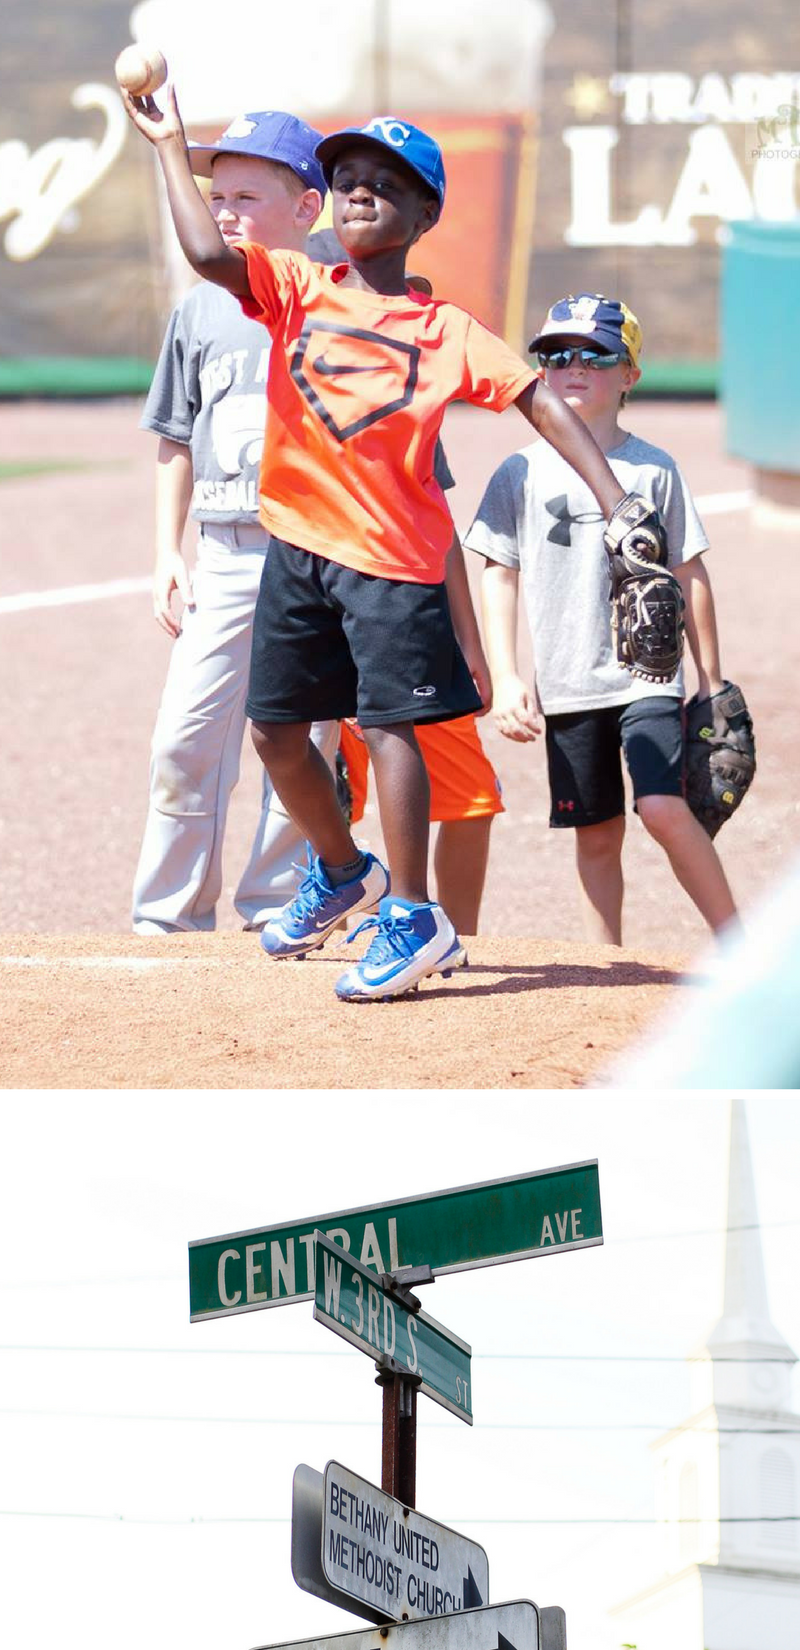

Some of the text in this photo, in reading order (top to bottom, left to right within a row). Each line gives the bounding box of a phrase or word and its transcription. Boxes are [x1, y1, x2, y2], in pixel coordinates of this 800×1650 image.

[609, 71, 800, 125] TRADI
[539, 1208, 584, 1246] AVE
[351, 1272, 397, 1357] 3RD
[455, 1375, 469, 1410] ST
[330, 1481, 439, 1572] BETHANY UNITED
[329, 1529, 402, 1598] METHODIST
